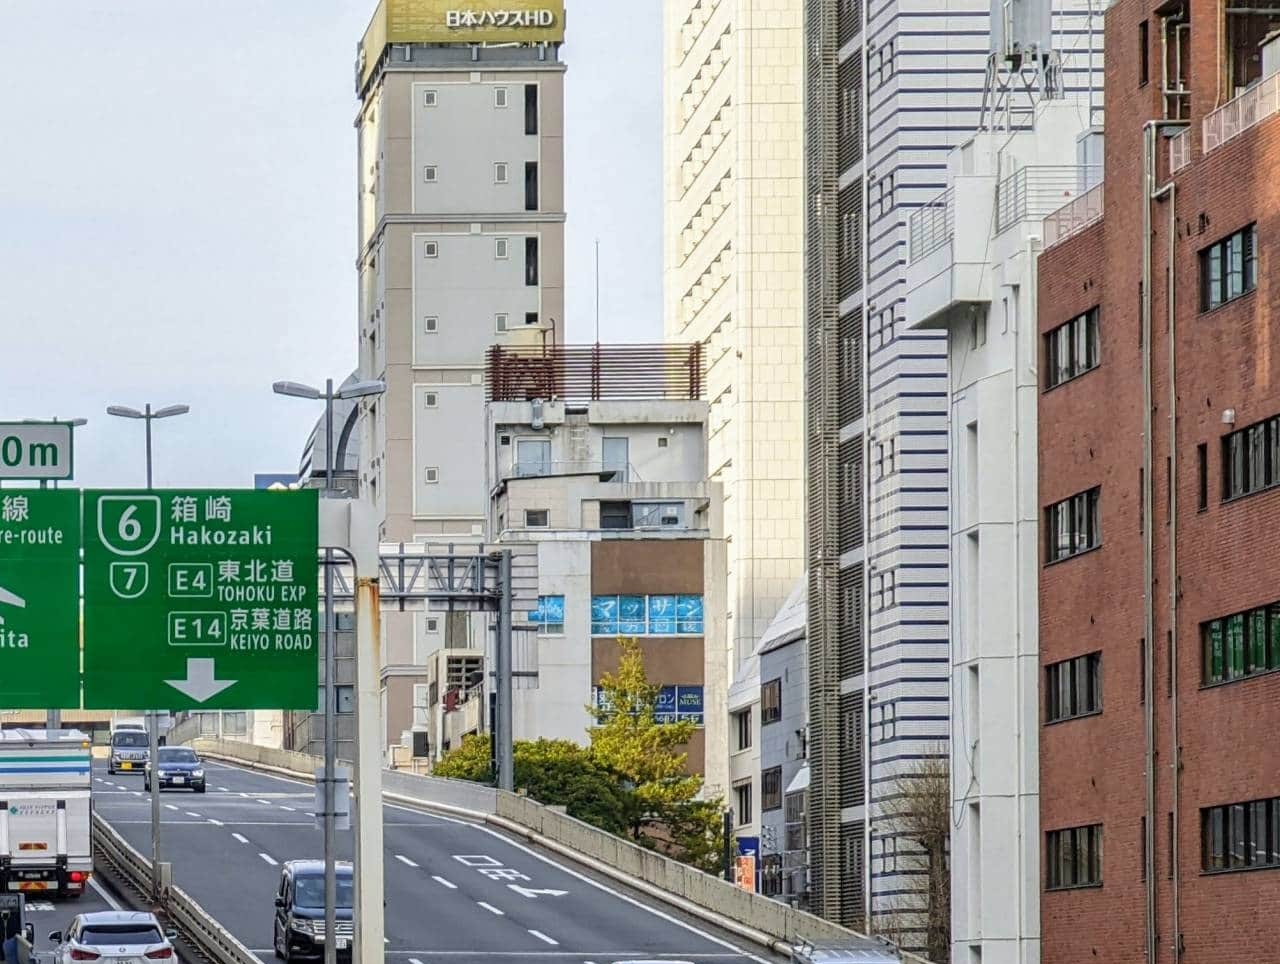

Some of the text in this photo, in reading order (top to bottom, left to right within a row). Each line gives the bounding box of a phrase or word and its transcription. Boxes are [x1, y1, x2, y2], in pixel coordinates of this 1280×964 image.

[446, 10, 553, 28] 日本ハウスHD
[171, 496, 232, 522] 箱崎
[118, 504, 141, 541] 6
[170, 525, 271, 545] Hakozaki
[123, 568, 137, 590] 7
[176, 570, 206, 590] E4
[217, 559, 294, 583] 東北道
[218, 585, 307, 601] TOHOKU EXP
[174, 618, 221, 639] E14
[230, 608, 313, 631] 京葉道路
[230, 634, 313, 650] KEIYO ROAD
